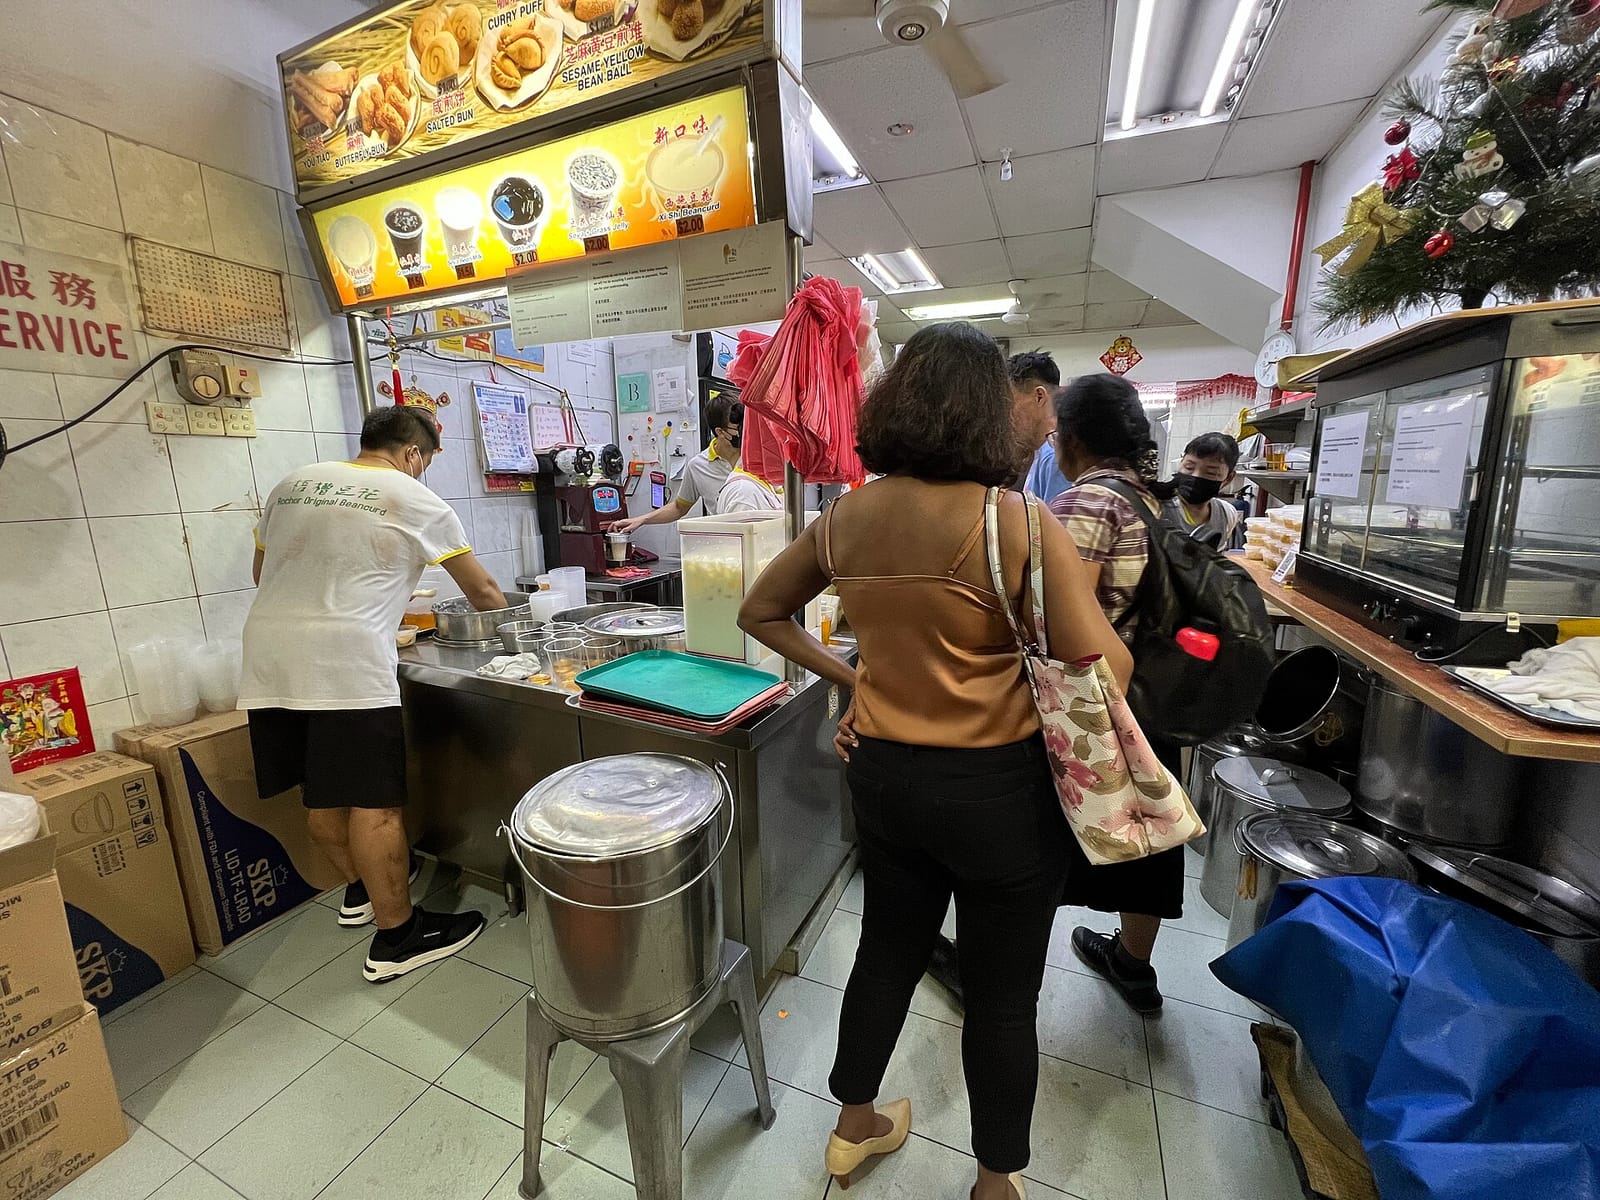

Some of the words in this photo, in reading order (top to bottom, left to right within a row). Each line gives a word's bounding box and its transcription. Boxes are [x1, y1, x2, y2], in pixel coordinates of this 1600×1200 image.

[488, 9, 517, 30] CURRY
[520, 0, 543, 18] PUFF
[561, 60, 601, 83] SESAME
[603, 44, 645, 68] YELLOW
[577, 73, 604, 92] BEAN
[606, 63, 632, 82] BALL
[426, 115, 455, 133] SALTED
[456, 108, 474, 123] BUN
[653, 115, 709, 146] 新口味
[303, 156, 317, 169] YOU
[316, 150, 331, 165] TIAO
[334, 149, 370, 169] BUTTERFLY
[370, 142, 386, 157] BUN
[659, 213, 667, 221] Xi
[668, 208, 682, 219] Shi
[682, 202, 720, 217] Beancurd
[676, 216, 704, 235] $2.00
[586, 236, 609, 251] $2.00
[514, 250, 538, 267] $2.00
[628, 381, 640, 402] B
[303, 496, 337, 507] Original
[339, 498, 388, 517] Beancurd
[197, 790, 211, 827] Compliant
[205, 825, 216, 841] with
[208, 839, 219, 857] FDA
[212, 855, 221, 869] and
[224, 848, 252, 924] LID-TF-LRAD
[246, 857, 277, 908] SKP
[75, 940, 115, 1000] SKP
[58, 1152, 83, 1173] FOR
[64, 1152, 95, 1178] OVEN
